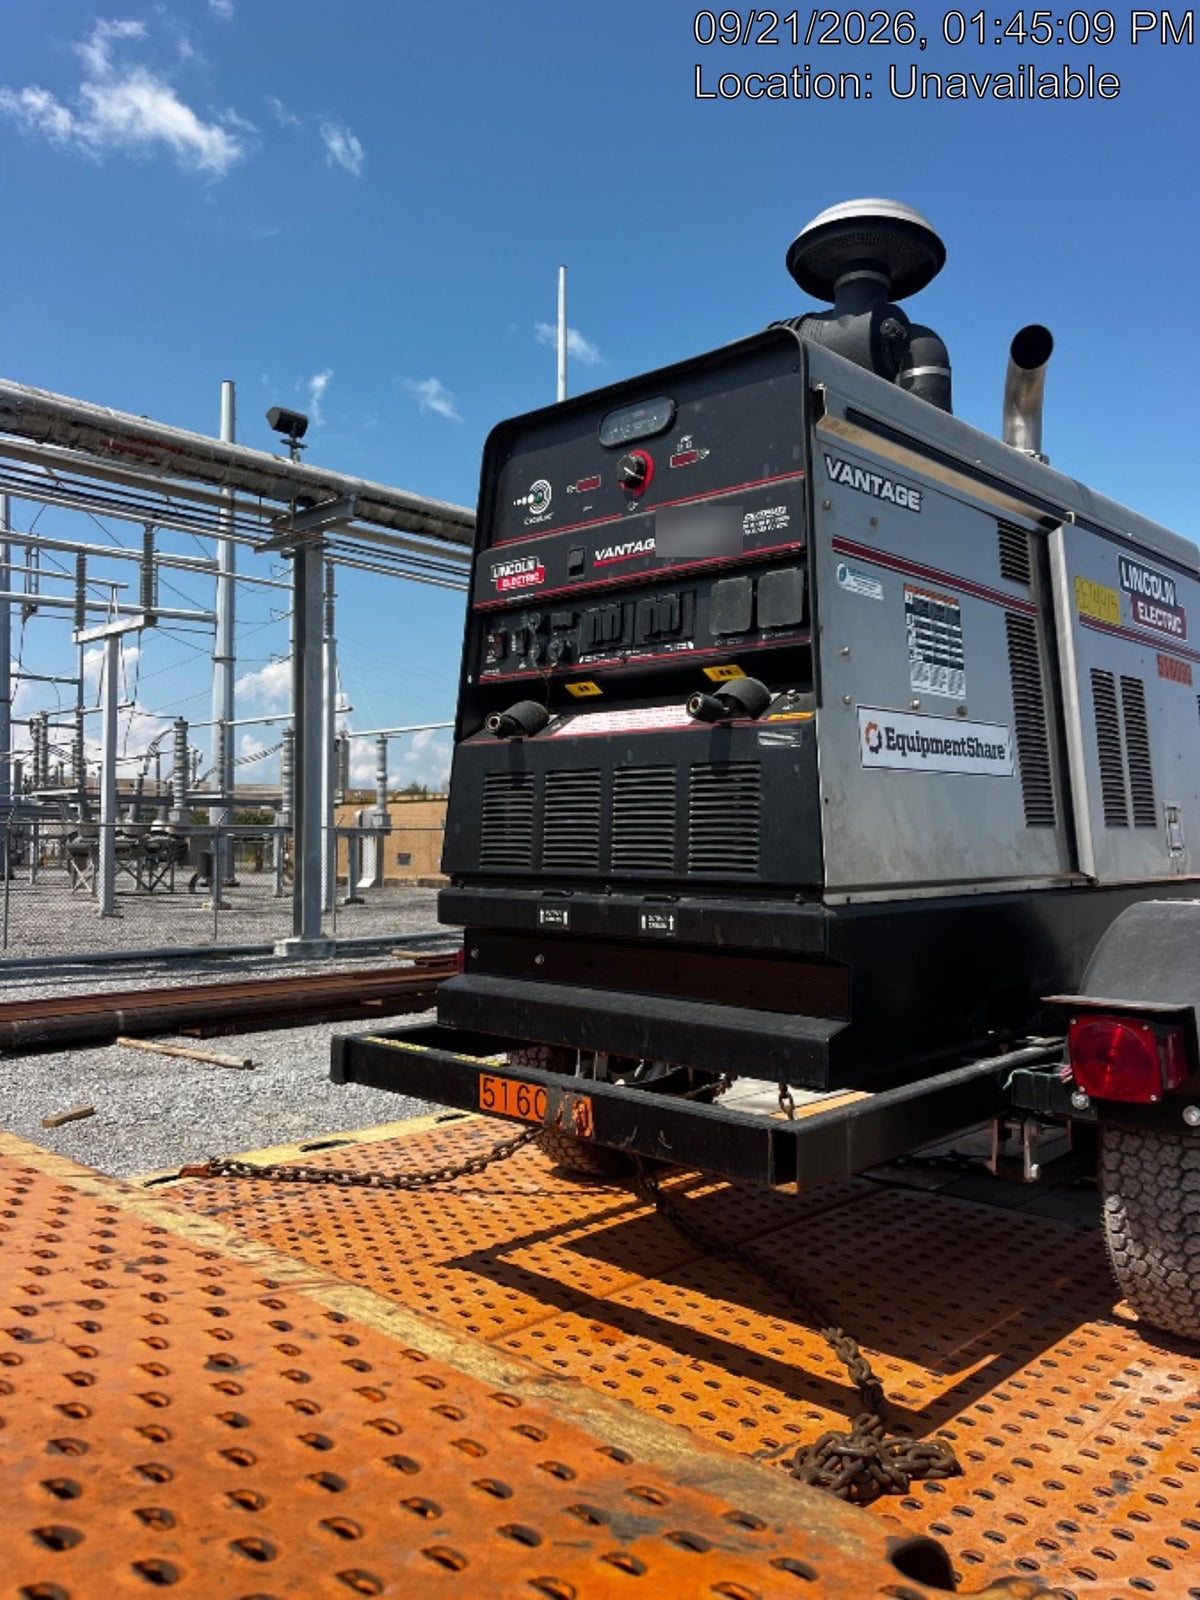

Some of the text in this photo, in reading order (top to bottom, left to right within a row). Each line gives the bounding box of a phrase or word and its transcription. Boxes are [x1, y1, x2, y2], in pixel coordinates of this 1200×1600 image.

[824, 455, 922, 512] VANTAGE
[594, 538, 656, 561] VANTAG
[493, 560, 537, 579] LINCOLN
[502, 571, 541, 587] ELECTRIC
[1121, 561, 1175, 606] LINCOLN
[1137, 601, 1182, 633] ELECTRIC
[884, 726, 1006, 760] EquipmentShare
